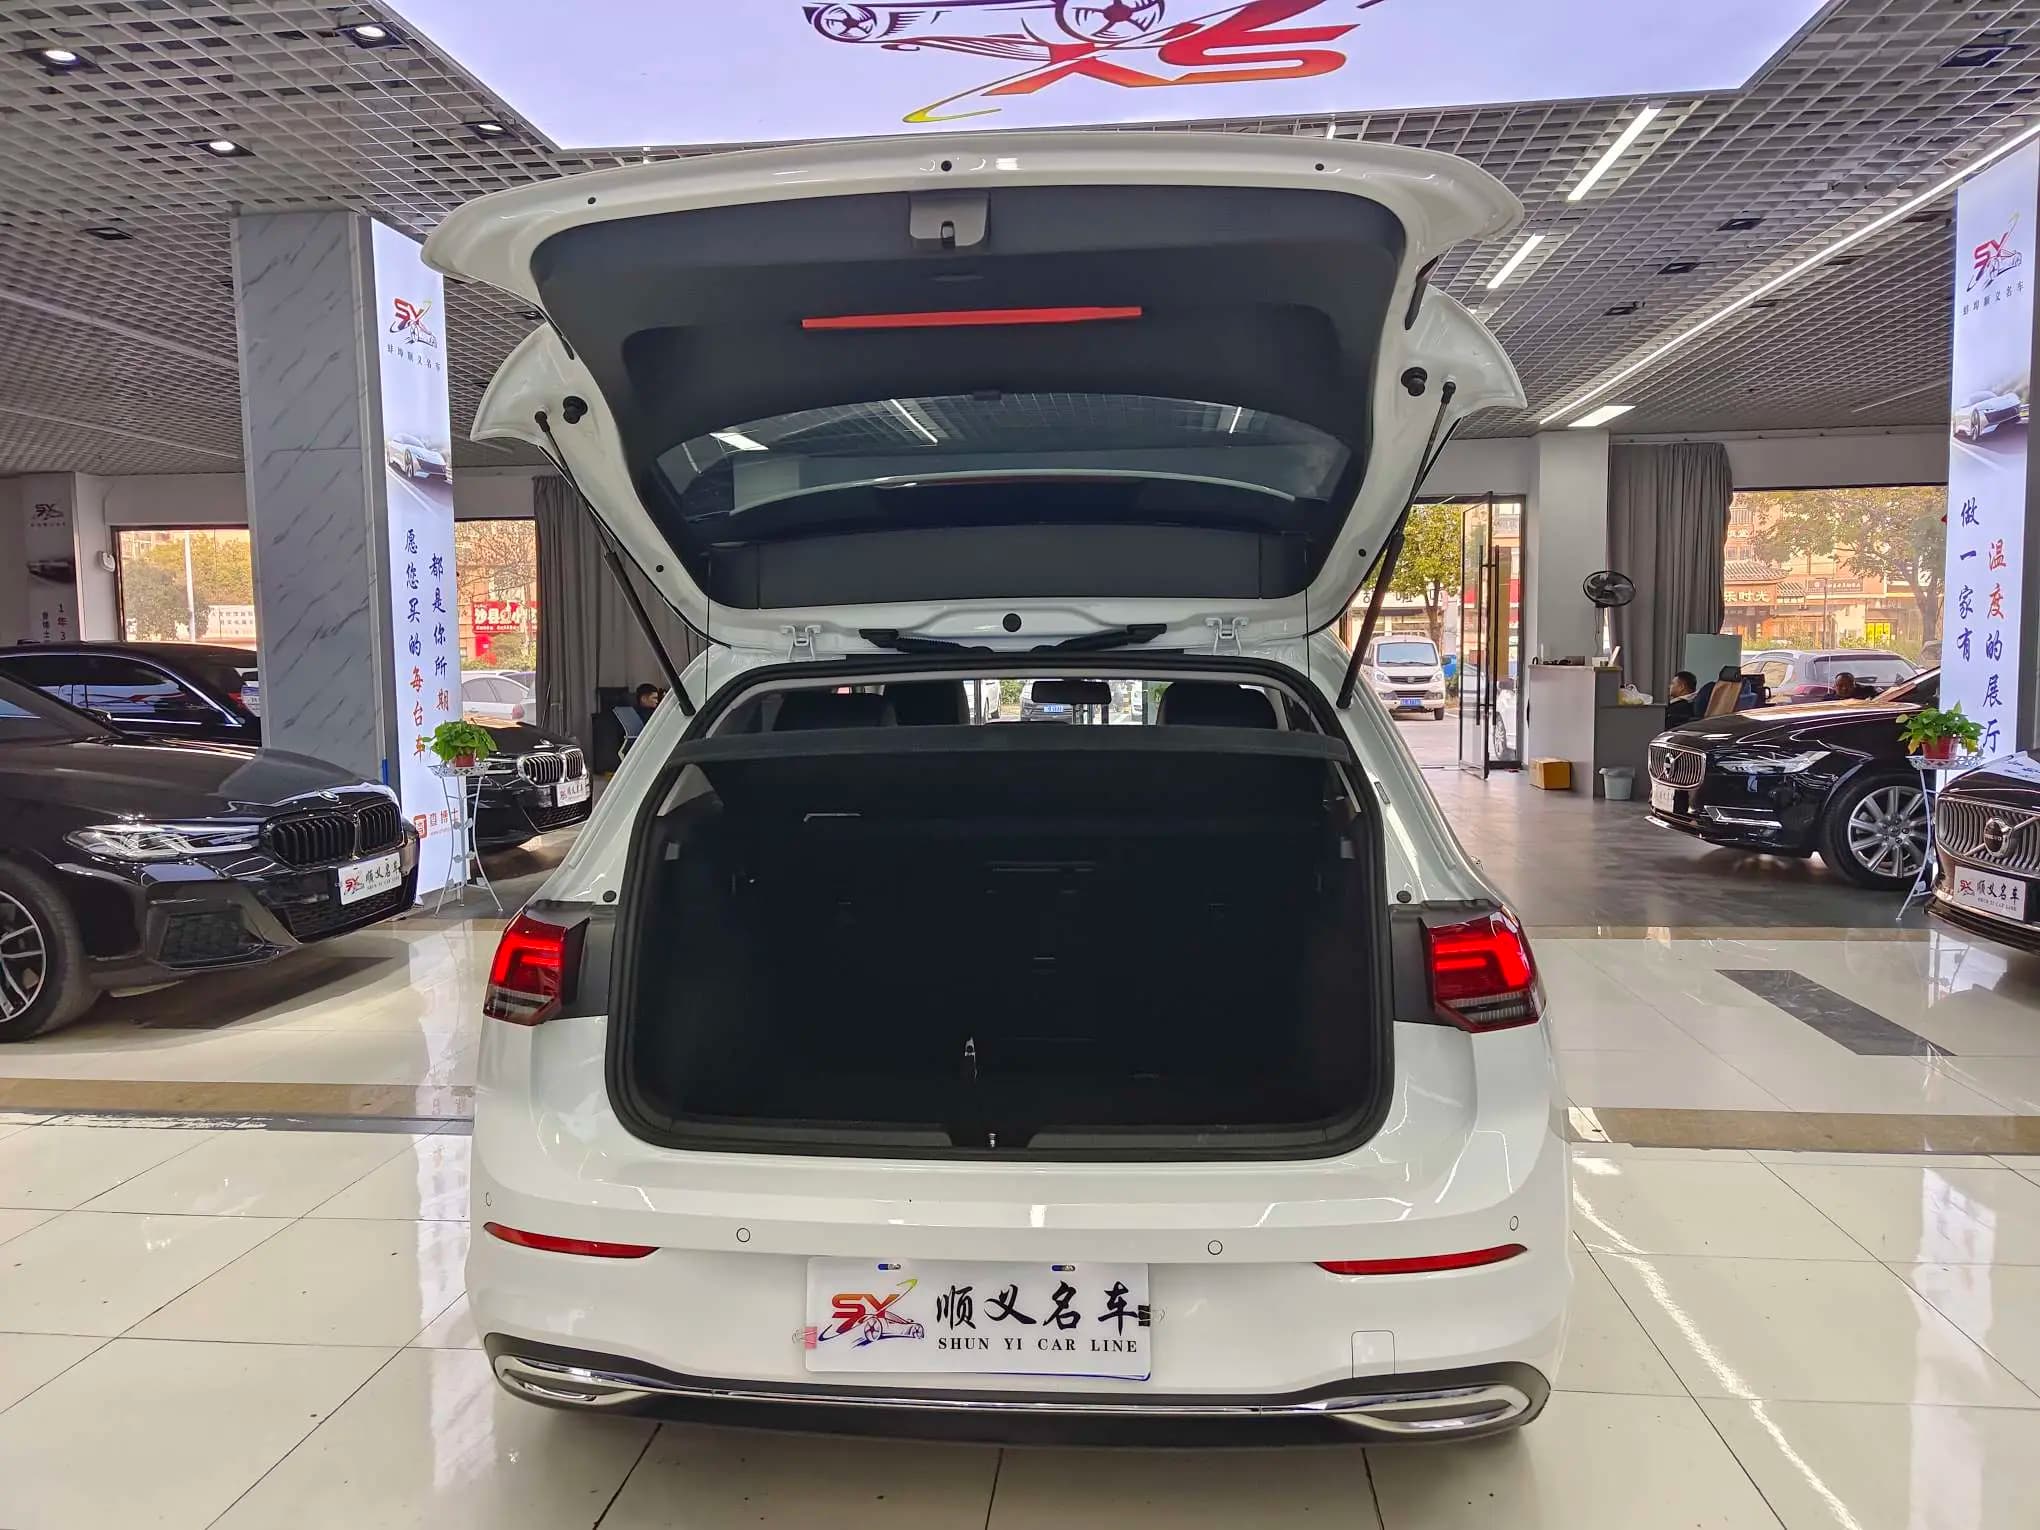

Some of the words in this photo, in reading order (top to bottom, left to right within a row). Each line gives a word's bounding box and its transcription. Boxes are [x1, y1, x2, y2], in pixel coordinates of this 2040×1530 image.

[1956, 497, 1980, 662] 做一家有
[1982, 538, 2007, 755] 温度的展厅
[935, 1280, 1139, 1336] 顺义名车
[938, 1337, 989, 1350] SHUN
[1005, 1337, 1022, 1350] YI
[1037, 1338, 1076, 1351] CAR
[1091, 1339, 1137, 1353] LINE
